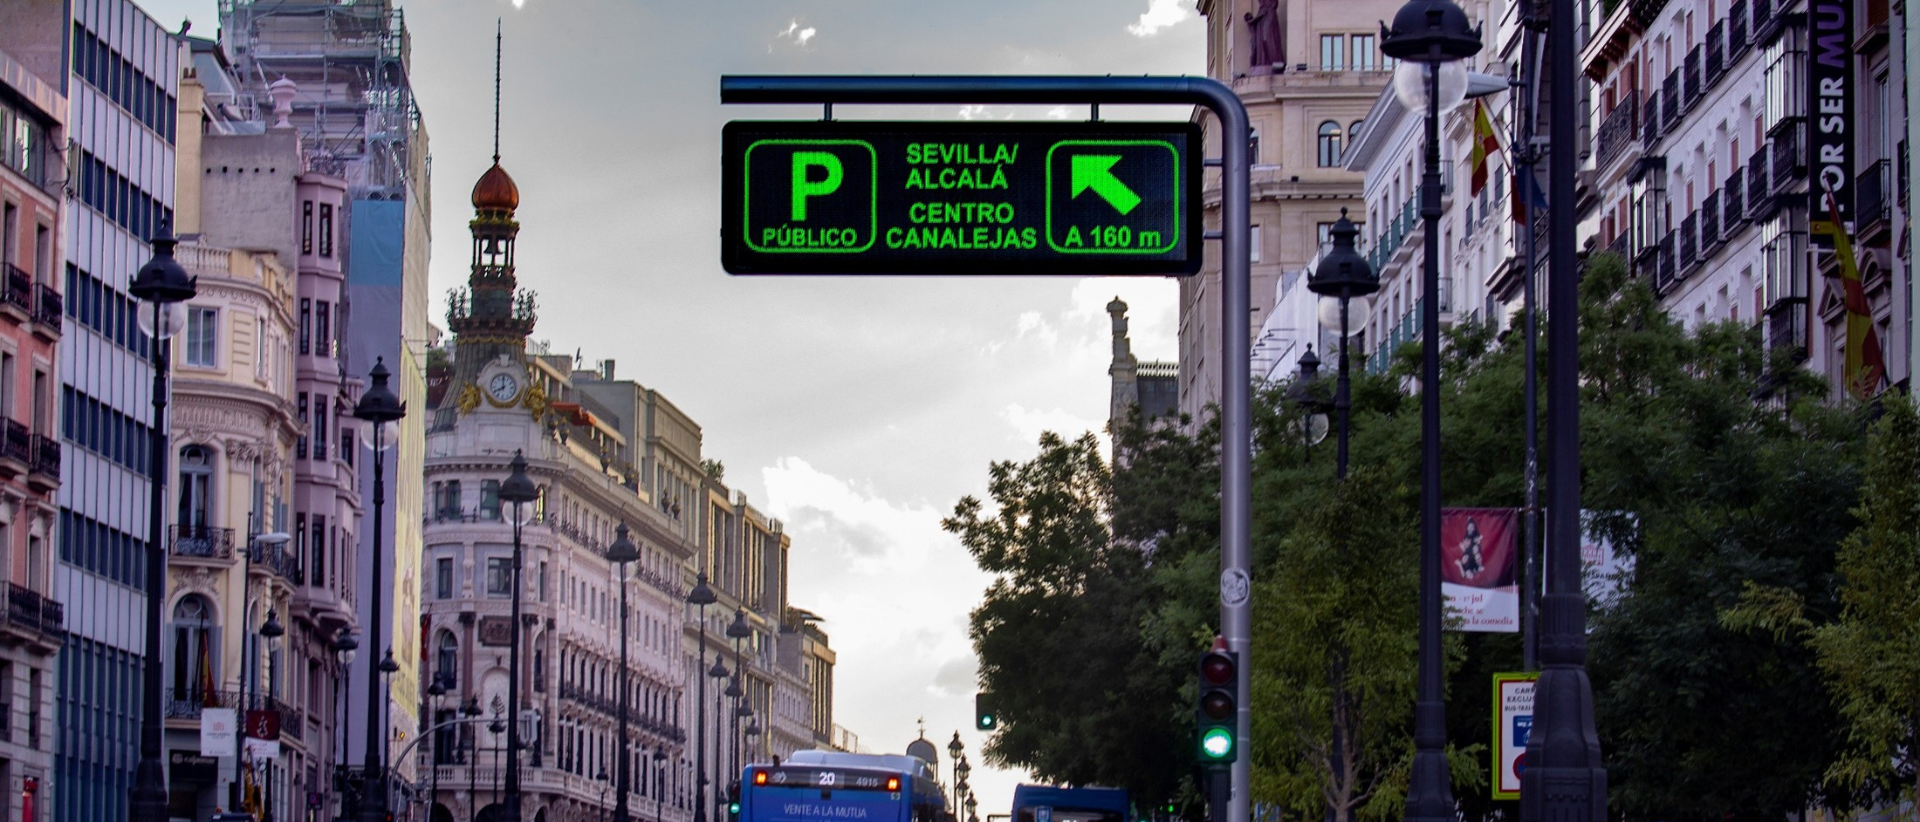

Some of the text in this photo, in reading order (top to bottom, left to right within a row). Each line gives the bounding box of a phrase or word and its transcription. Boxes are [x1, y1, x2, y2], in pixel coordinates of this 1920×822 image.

[1816, 0, 1847, 213] POR SER MU
[906, 143, 1019, 164] SEVILLA/
[791, 151, 844, 221] P
[905, 163, 1009, 190] ALCALÁ
[909, 202, 1015, 224] CENTRO
[762, 223, 858, 247] PÚBLICO
[886, 227, 1037, 250] CANALEJAS
[1064, 226, 1161, 248] A 160 m
[1471, 594, 1483, 604] jul
[1472, 616, 1479, 624] la
[1480, 616, 1513, 625] comedia
[818, 771, 836, 786] 20
[784, 803, 867, 819] VENTE A LA MUTUA
